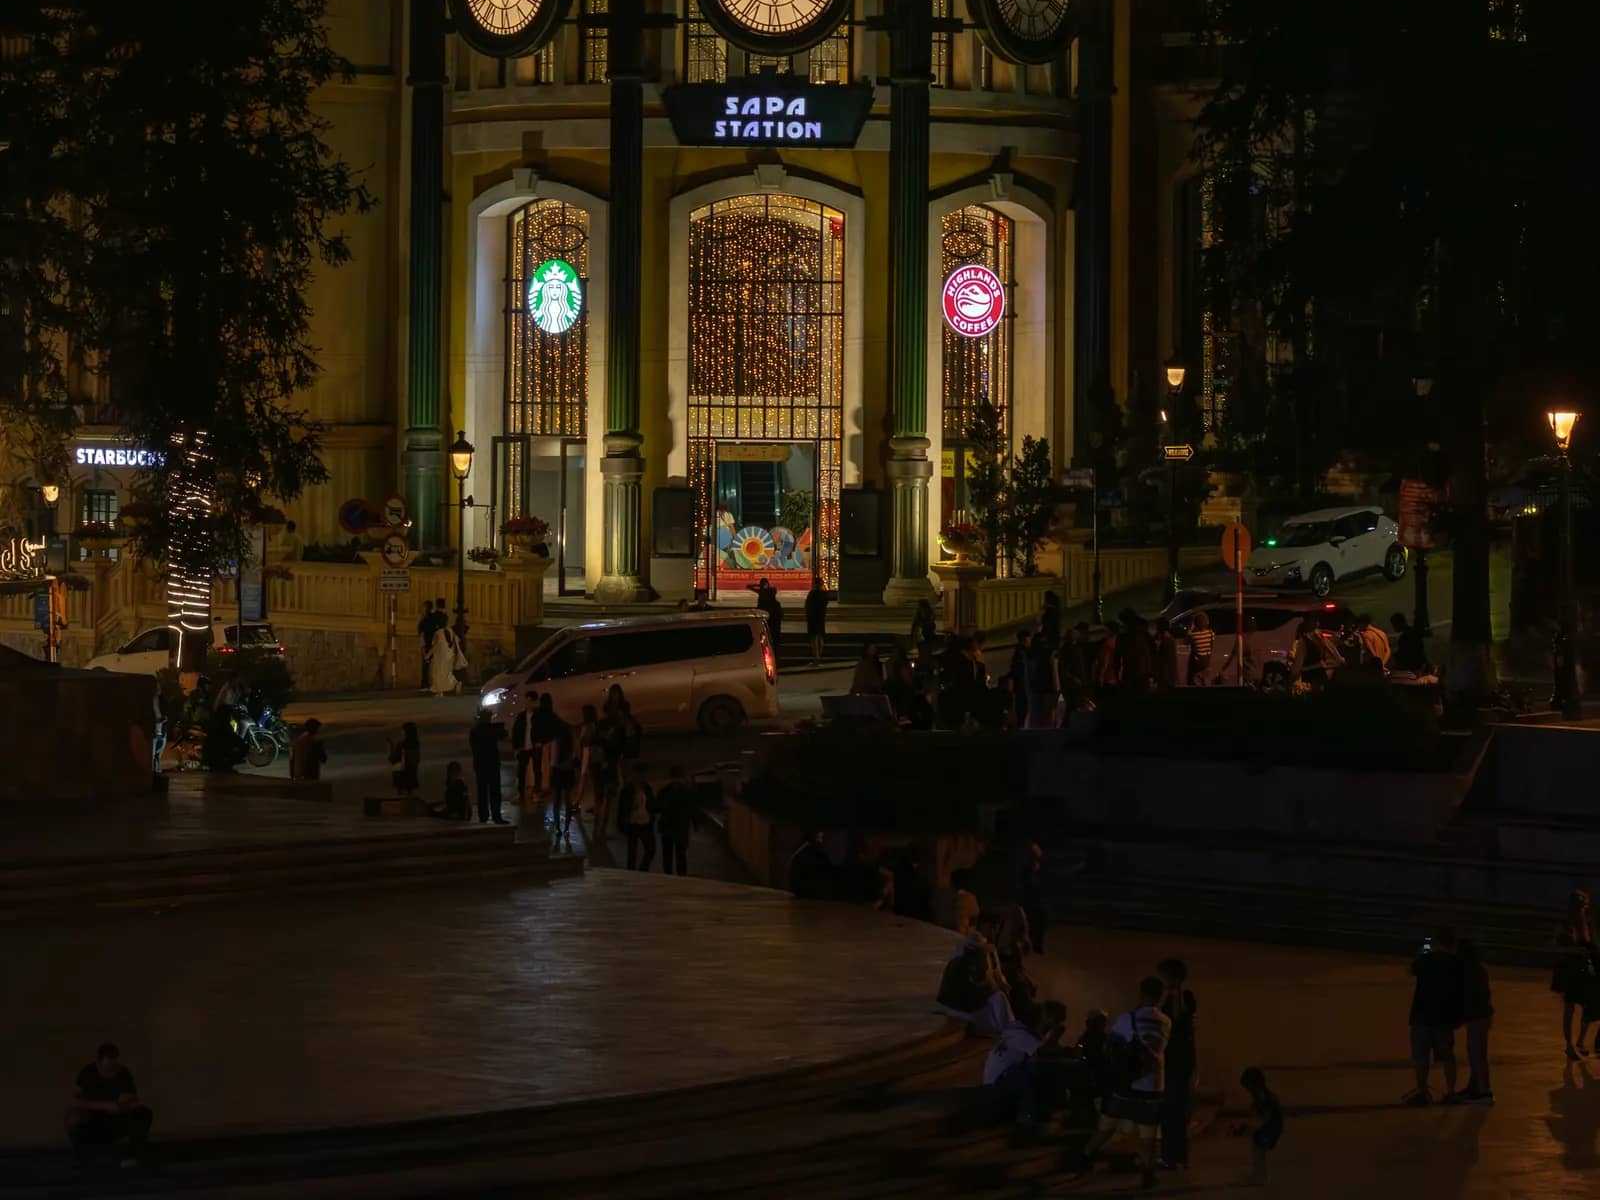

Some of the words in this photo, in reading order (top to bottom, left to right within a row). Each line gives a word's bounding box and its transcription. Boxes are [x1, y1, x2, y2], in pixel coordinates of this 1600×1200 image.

[725, 96, 806, 116] SAPA
[714, 120, 822, 140] STATION
[947, 270, 1000, 298] HIGHLANDS
[953, 315, 994, 333] COFFEE
